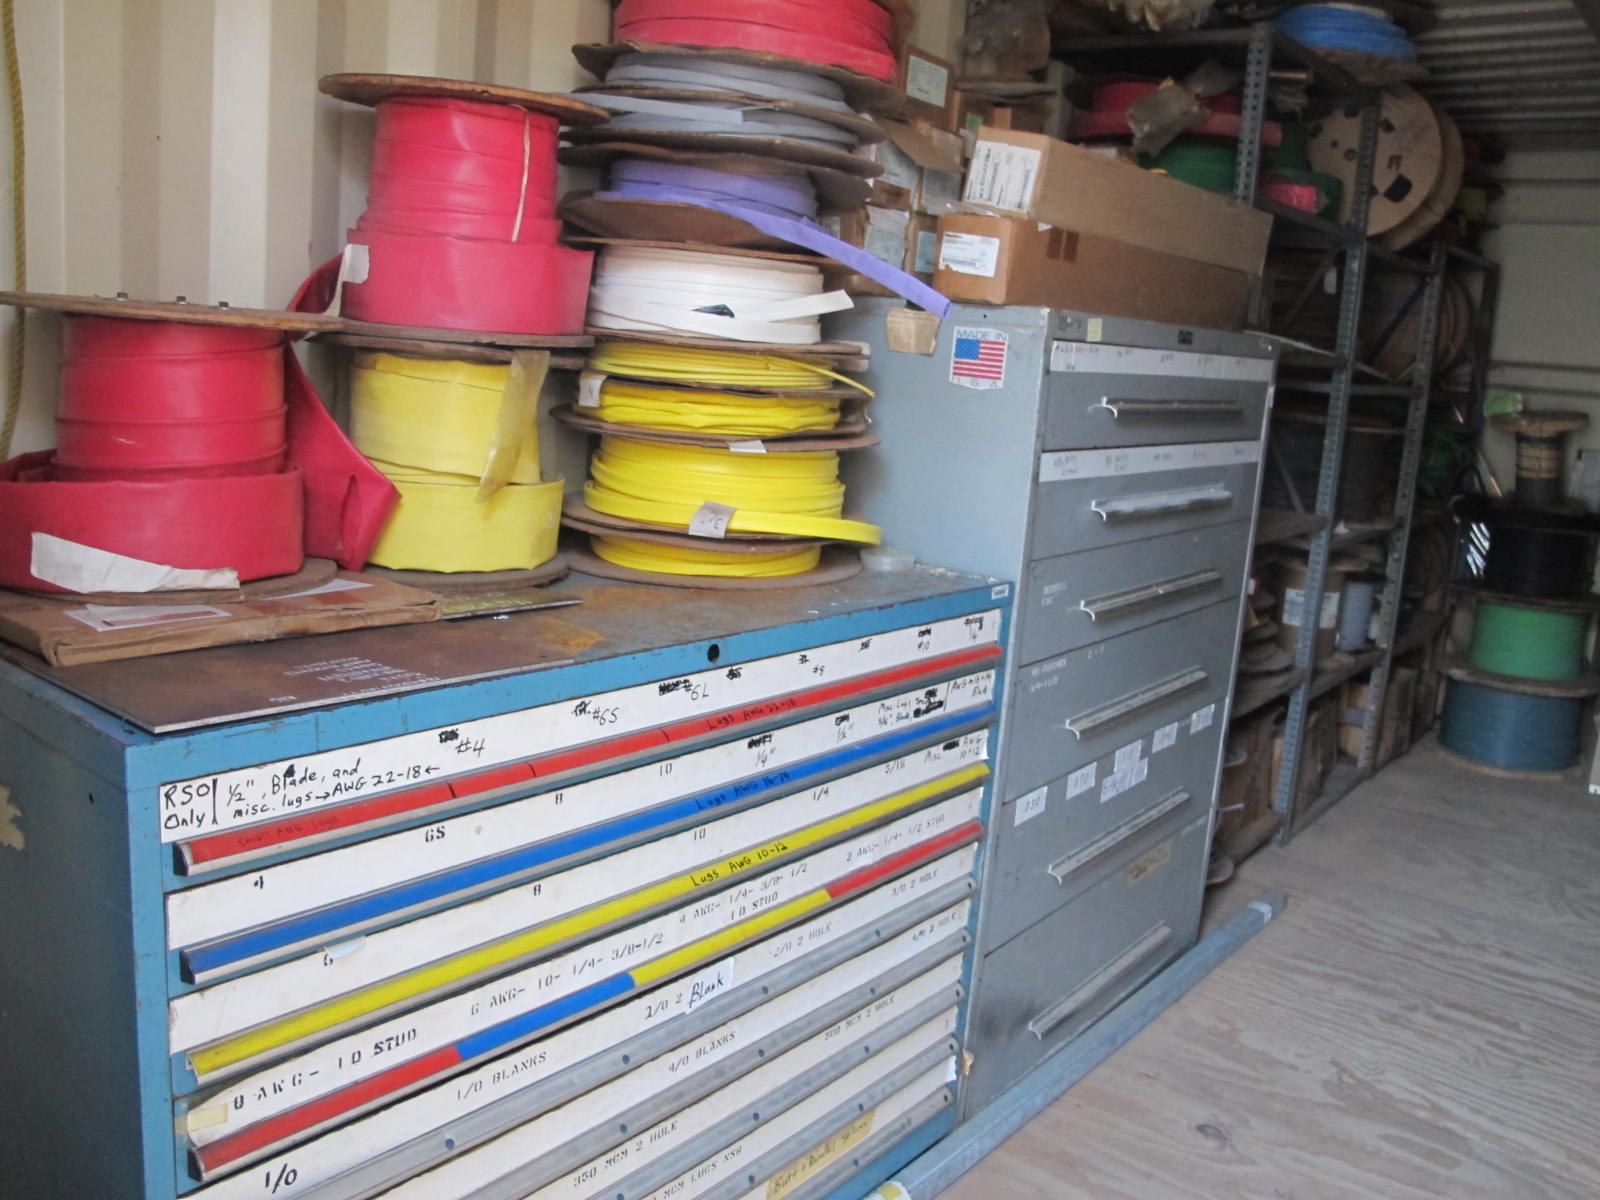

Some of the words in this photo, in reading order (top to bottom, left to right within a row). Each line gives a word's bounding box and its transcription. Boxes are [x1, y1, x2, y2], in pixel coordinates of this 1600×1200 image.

[955, 328, 987, 341] MADE
[994, 332, 1007, 342] IN
[592, 706, 619, 726] #6S
[705, 714, 735, 731] Lugs
[454, 738, 486, 757] #4
[331, 757, 362, 780] and
[658, 762, 673, 776] 10
[163, 782, 211, 810] RSO
[232, 802, 276, 820] misc.
[281, 789, 313, 811] lugs
[331, 778, 368, 798] AWG
[372, 765, 422, 788] 22-18
[696, 791, 727, 811] Lugs
[733, 779, 759, 797] AWG
[811, 786, 830, 801] 1/4
[163, 809, 207, 831] Only
[692, 827, 707, 841] 10
[689, 867, 721, 888] Lugs
[728, 857, 752, 874] AWG
[756, 842, 788, 861] 10-12
[730, 906, 747, 922] 10
[751, 890, 779, 912] STUD
[808, 921, 833, 940] HOLE
[470, 1002, 480, 1017] 6
[644, 999, 669, 1020] 2/0
[874, 995, 896, 1013] HOLE
[337, 1050, 362, 1071] 10
[373, 1027, 418, 1058] STUD
[694, 1030, 737, 1060] BLANKS
[455, 1080, 483, 1101] 1/0
[491, 1050, 548, 1085] BLANKS
[572, 1166, 598, 1188] 350
[603, 1147, 629, 1170] MCM
[649, 1119, 679, 1145] HOLE
[263, 1162, 299, 1195] 1/0
[689, 1160, 718, 1184] LUGS
